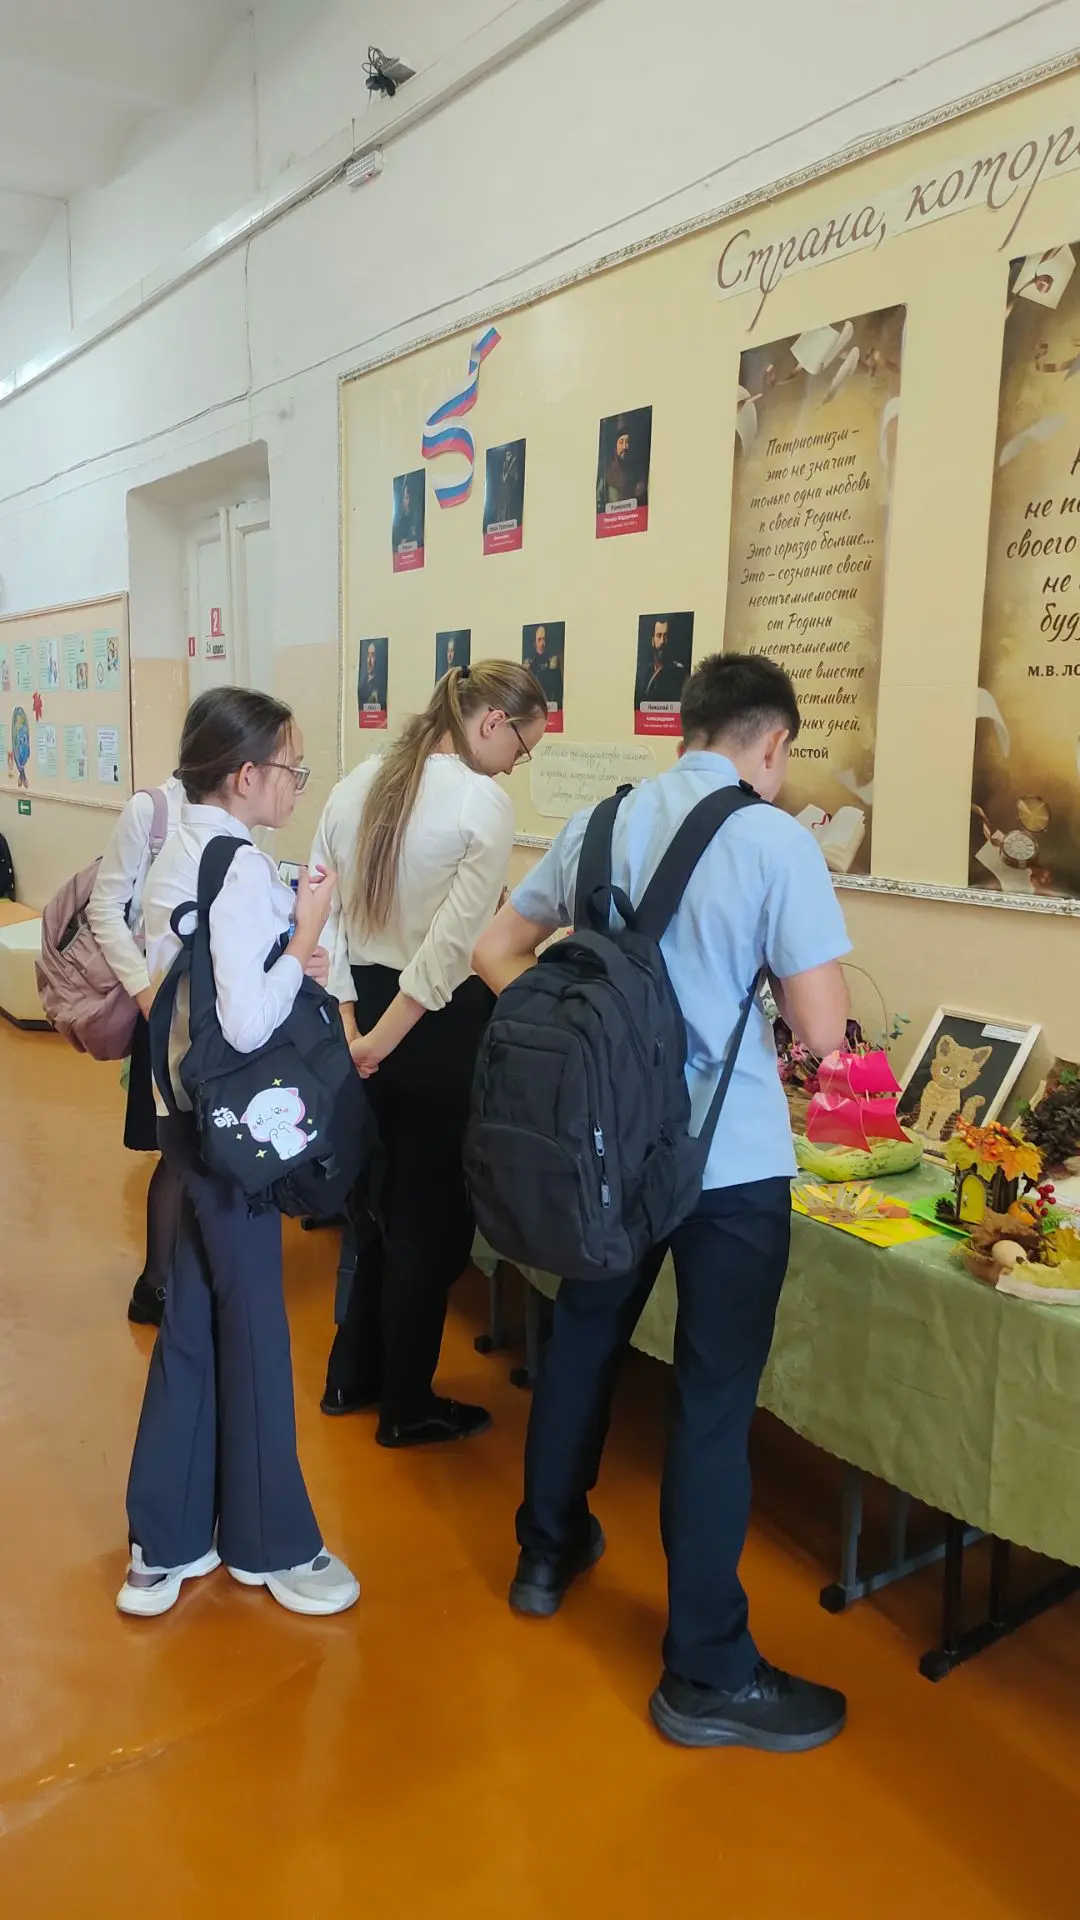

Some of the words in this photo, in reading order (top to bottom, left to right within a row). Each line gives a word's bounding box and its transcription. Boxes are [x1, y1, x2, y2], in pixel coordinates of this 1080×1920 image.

[716, 204, 886, 332] Страна,
[904, 124, 1080, 252] котор
[766, 430, 848, 457] Патриотизм
[765, 468, 788, 481] это
[791, 464, 806, 476] не
[805, 454, 856, 480] значит
[750, 492, 791, 508] только
[794, 487, 822, 508] одна
[826, 472, 871, 496] любовь
[1025, 498, 1053, 519] не
[759, 521, 765, 533] к
[769, 512, 801, 531] своей
[804, 508, 851, 530] Родине.
[746, 543, 772, 560] Это
[774, 540, 818, 559] гораздо
[820, 531, 874, 549] больше...
[1007, 528, 1076, 559] своего
[740, 568, 765, 584] Это
[778, 563, 833, 586] сознание
[837, 554, 872, 573] своей
[1042, 574, 1072, 595] не
[749, 588, 858, 608] неотъемлемости
[767, 619, 784, 631] от
[788, 613, 833, 635] Родины
[1040, 602, 1080, 642] буд
[759, 641, 850, 656] неотъемлемое
[816, 661, 865, 680] вместе
[796, 687, 857, 705] астливых
[827, 716, 861, 737] дней.
[212, 1106, 239, 1128] 萌
